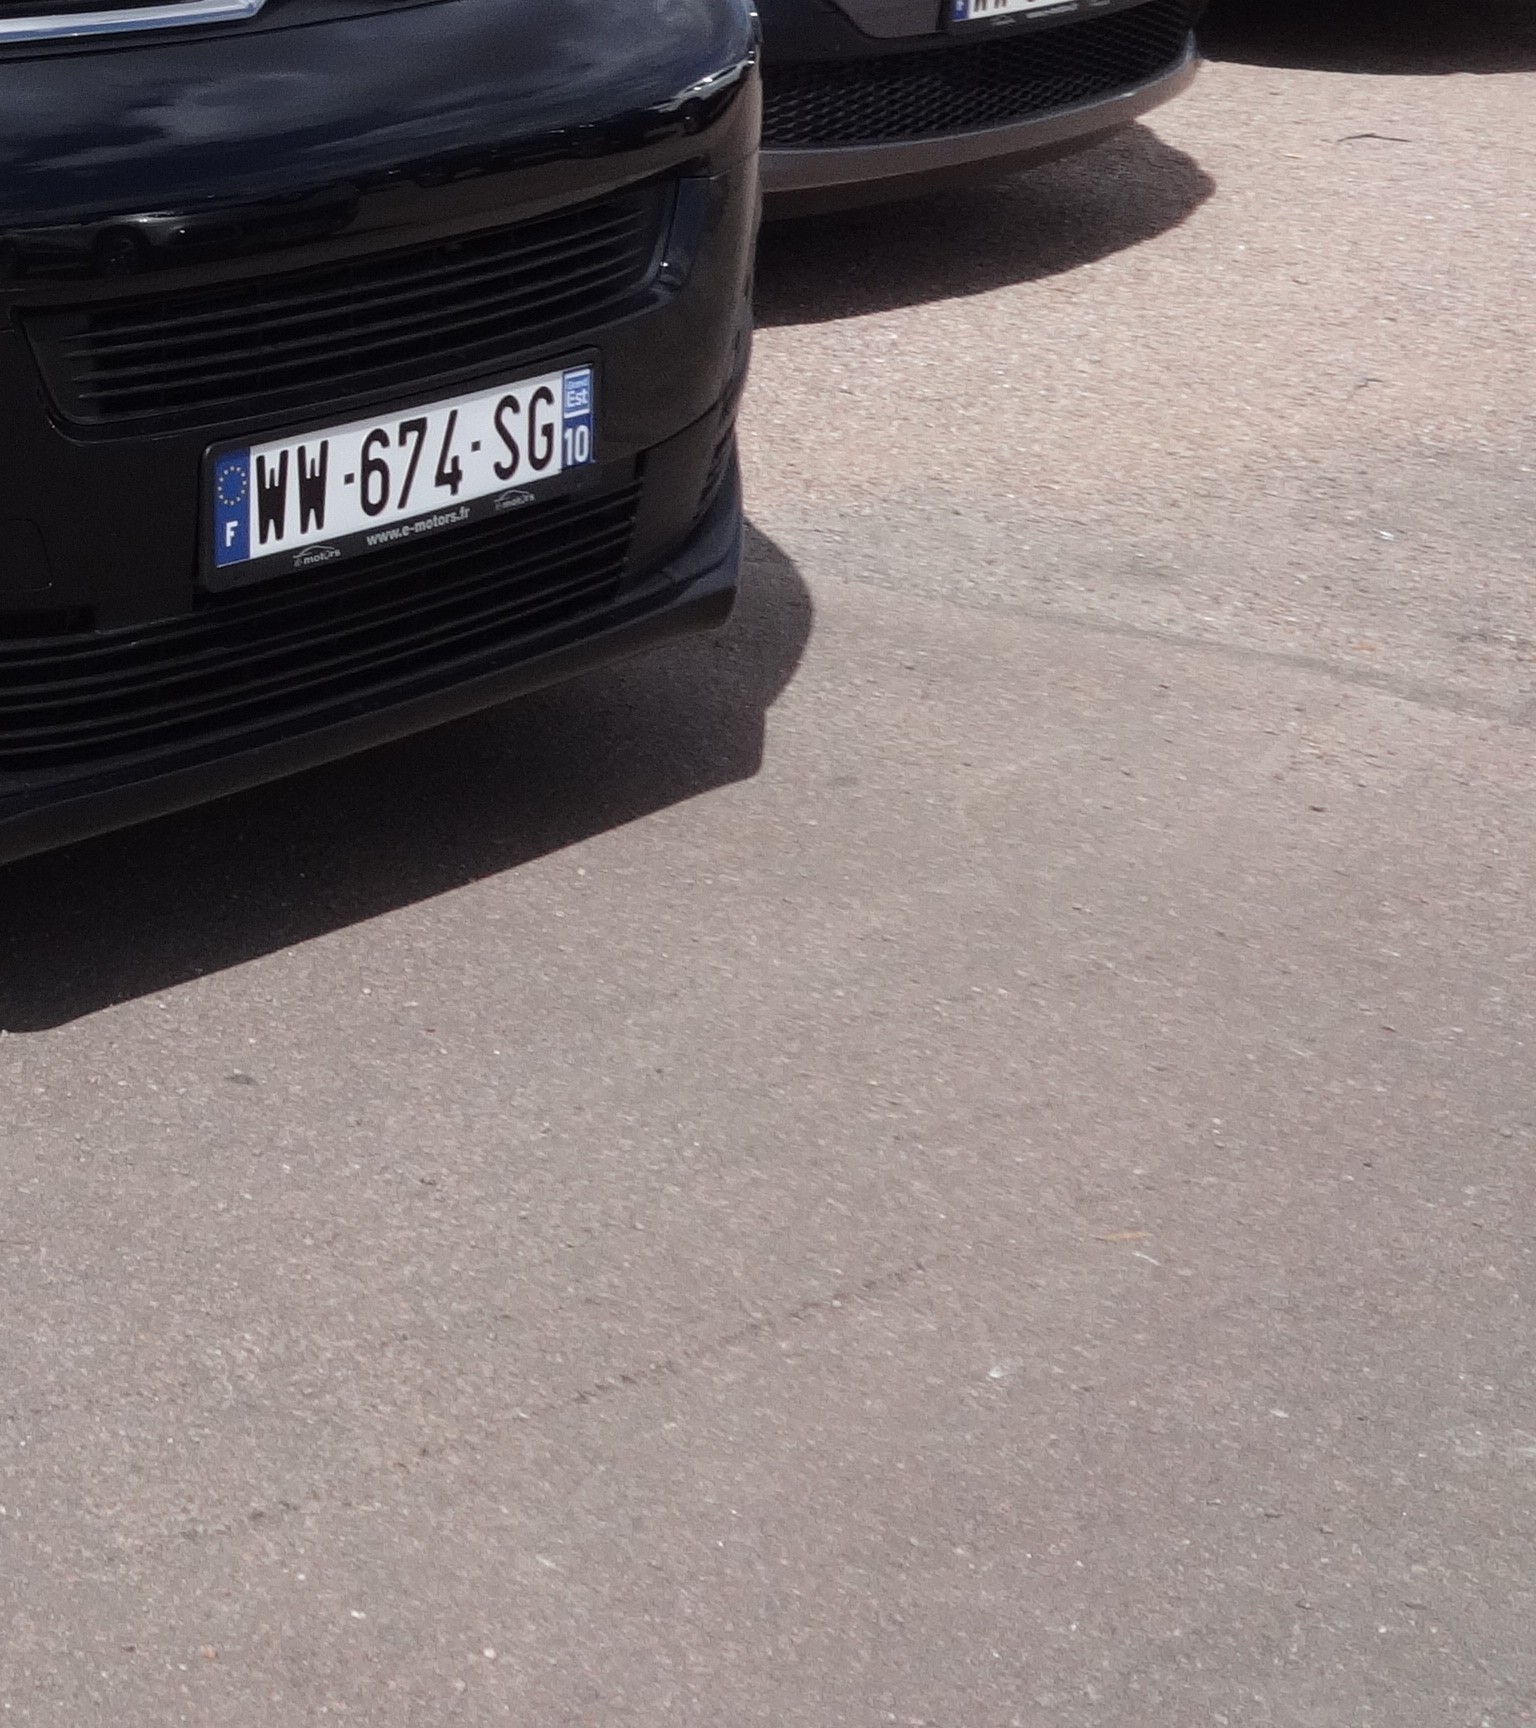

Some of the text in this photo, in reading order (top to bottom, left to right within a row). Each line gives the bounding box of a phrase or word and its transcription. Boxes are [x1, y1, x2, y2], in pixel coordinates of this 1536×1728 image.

[567, 388, 588, 409] Est
[564, 424, 589, 466] 10
[226, 521, 238, 547] F
[366, 505, 471, 546] www.e-motors.fr
